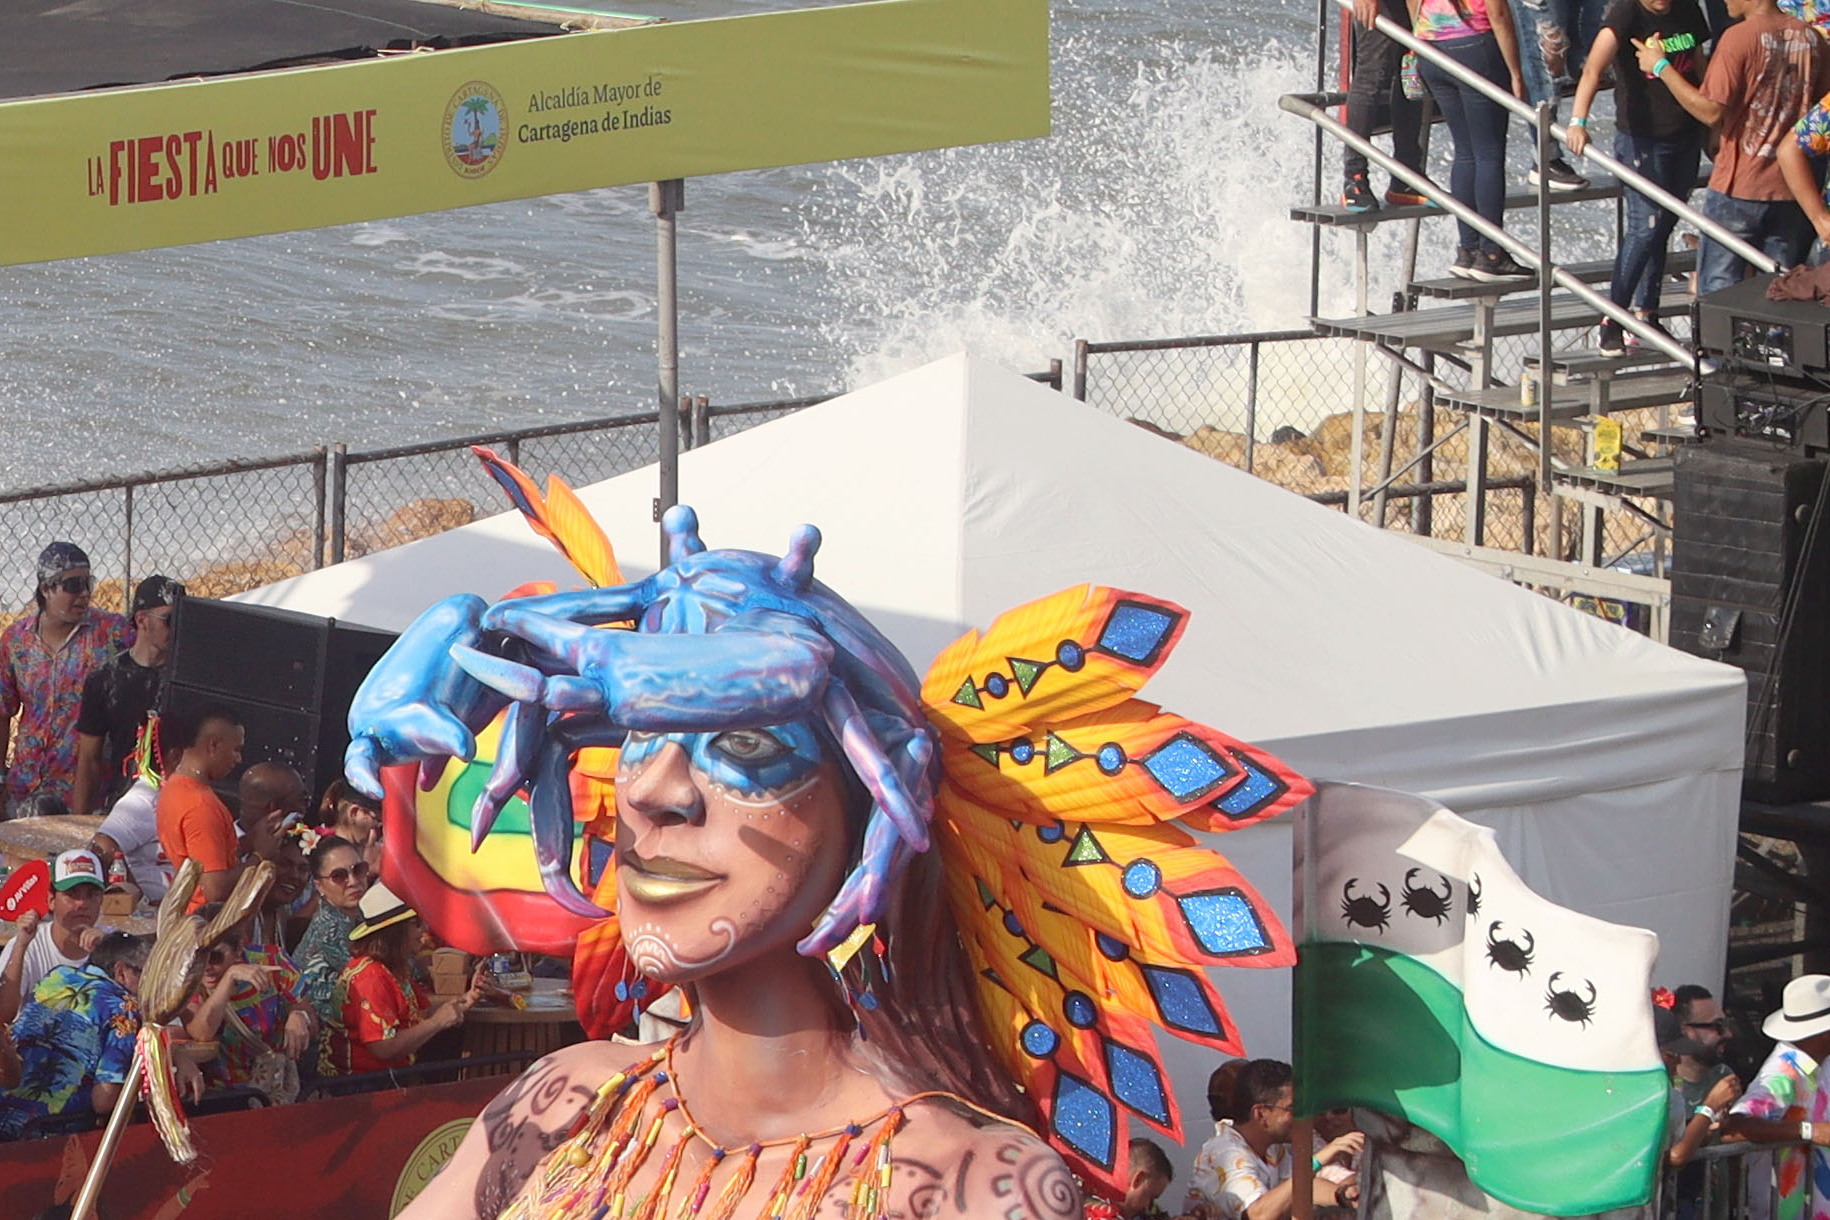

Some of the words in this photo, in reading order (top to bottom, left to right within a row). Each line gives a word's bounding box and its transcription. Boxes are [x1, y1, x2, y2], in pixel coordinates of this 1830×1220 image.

[528, 86, 590, 113] Alcaldía
[593, 82, 642, 106] Mayor
[643, 76, 662, 97] de
[518, 120, 599, 143] Cartagena
[601, 112, 620, 132] de
[622, 106, 672, 129] Indias
[87, 156, 105, 197] LA
[109, 129, 218, 206] FIESTA
[222, 138, 259, 179] QUE
[268, 132, 307, 174] NOS
[312, 109, 378, 181] UNE
